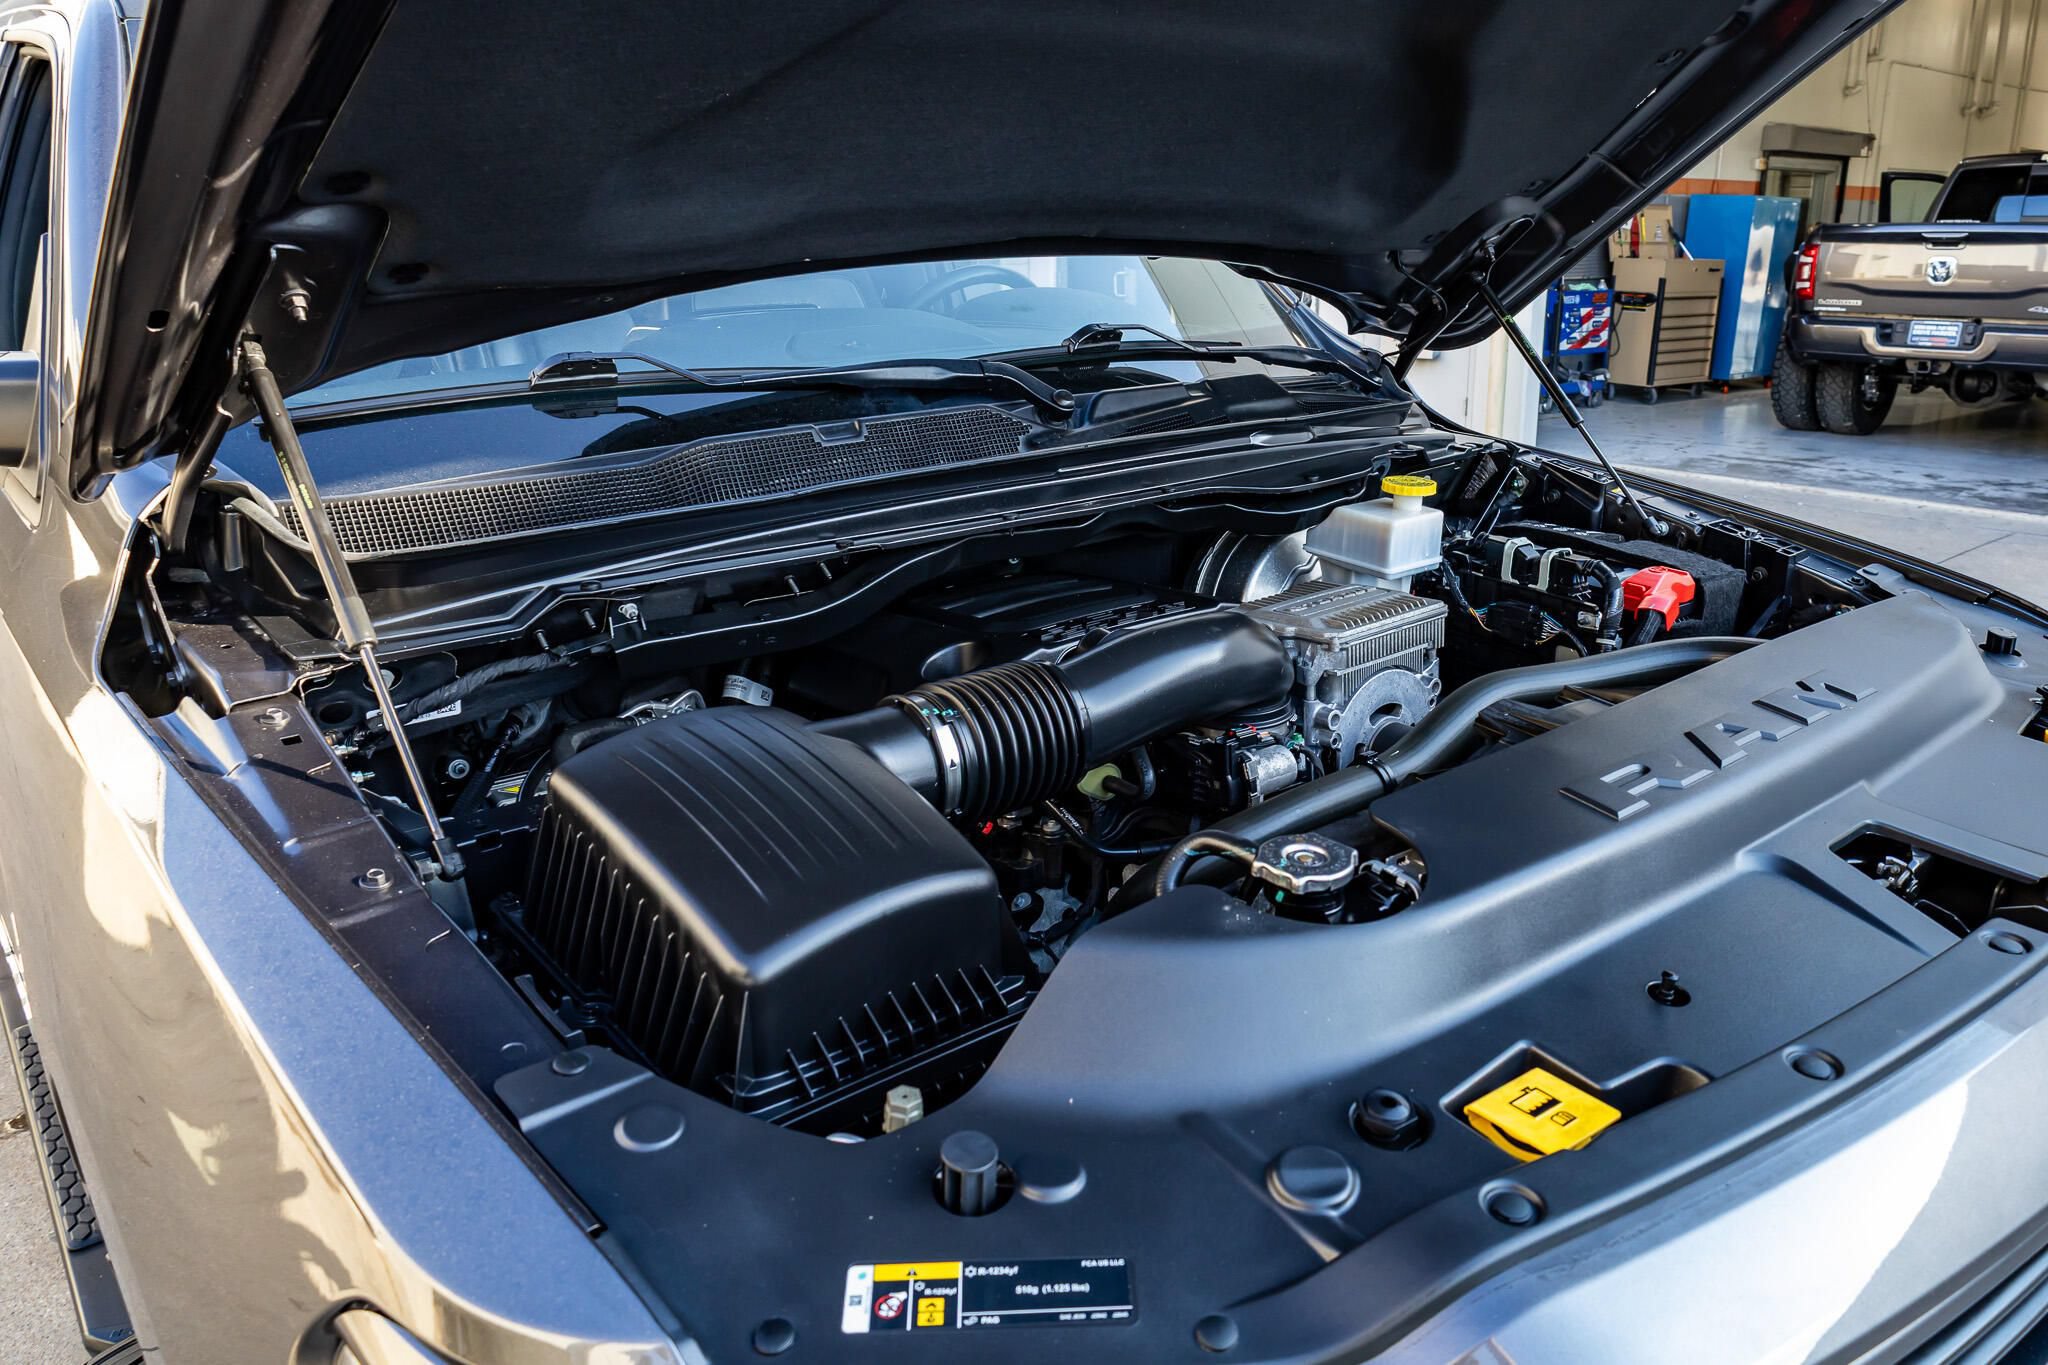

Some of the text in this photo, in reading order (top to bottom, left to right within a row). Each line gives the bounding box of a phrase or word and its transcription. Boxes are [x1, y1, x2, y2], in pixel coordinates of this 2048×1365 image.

[1558, 670, 1878, 821] RAM
[1081, 1259, 1097, 1267] FCA
[977, 1265, 1019, 1276] R-1234yf
